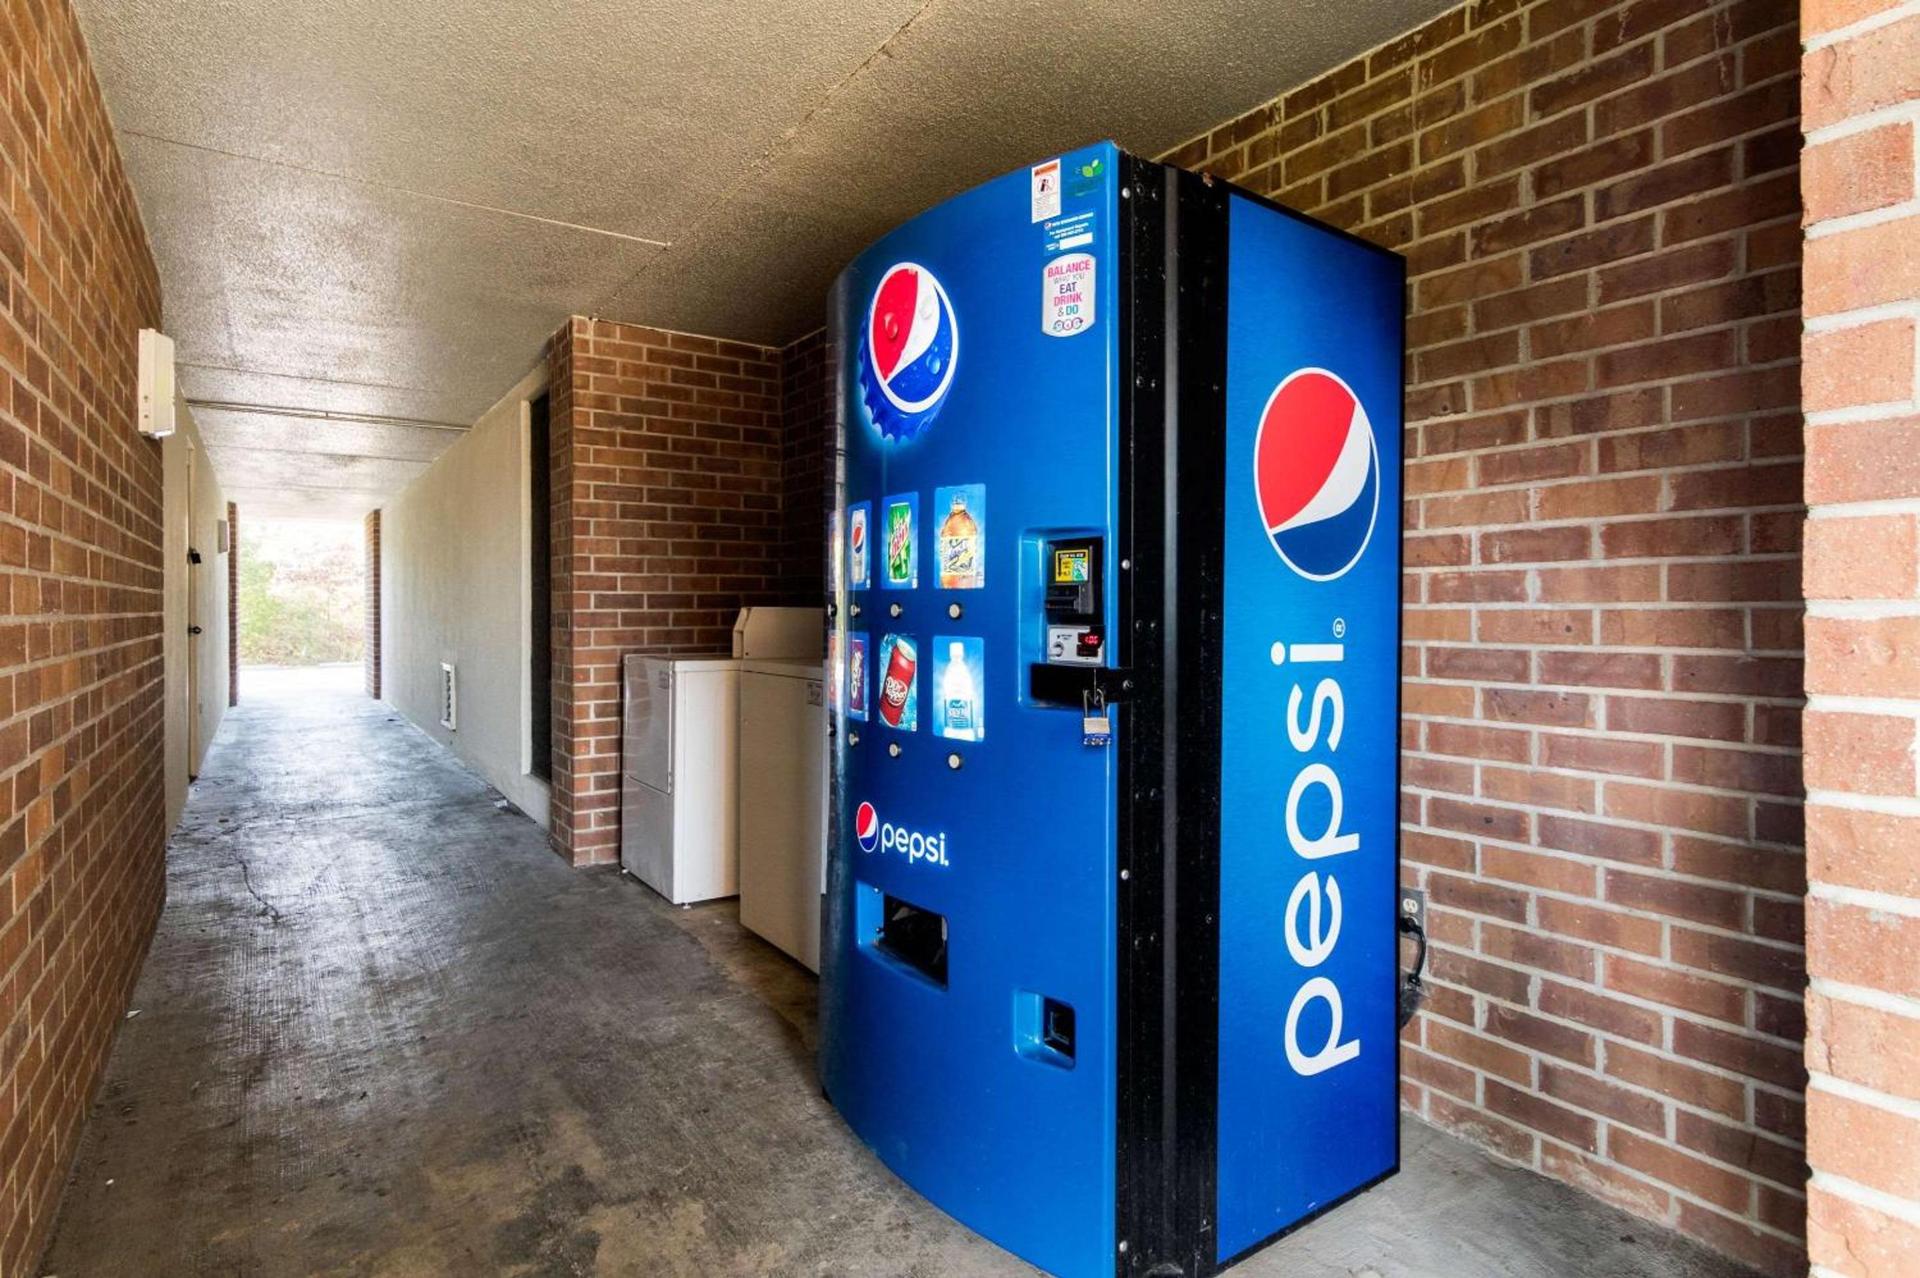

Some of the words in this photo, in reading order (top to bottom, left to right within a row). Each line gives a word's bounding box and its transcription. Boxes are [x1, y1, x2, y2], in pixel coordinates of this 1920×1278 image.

[1048, 260, 1091, 277] BALANCE
[1059, 281, 1077, 294] EAT
[1054, 292, 1082, 306] DRINK
[1057, 306, 1065, 317] &
[1066, 304, 1079, 316] DO
